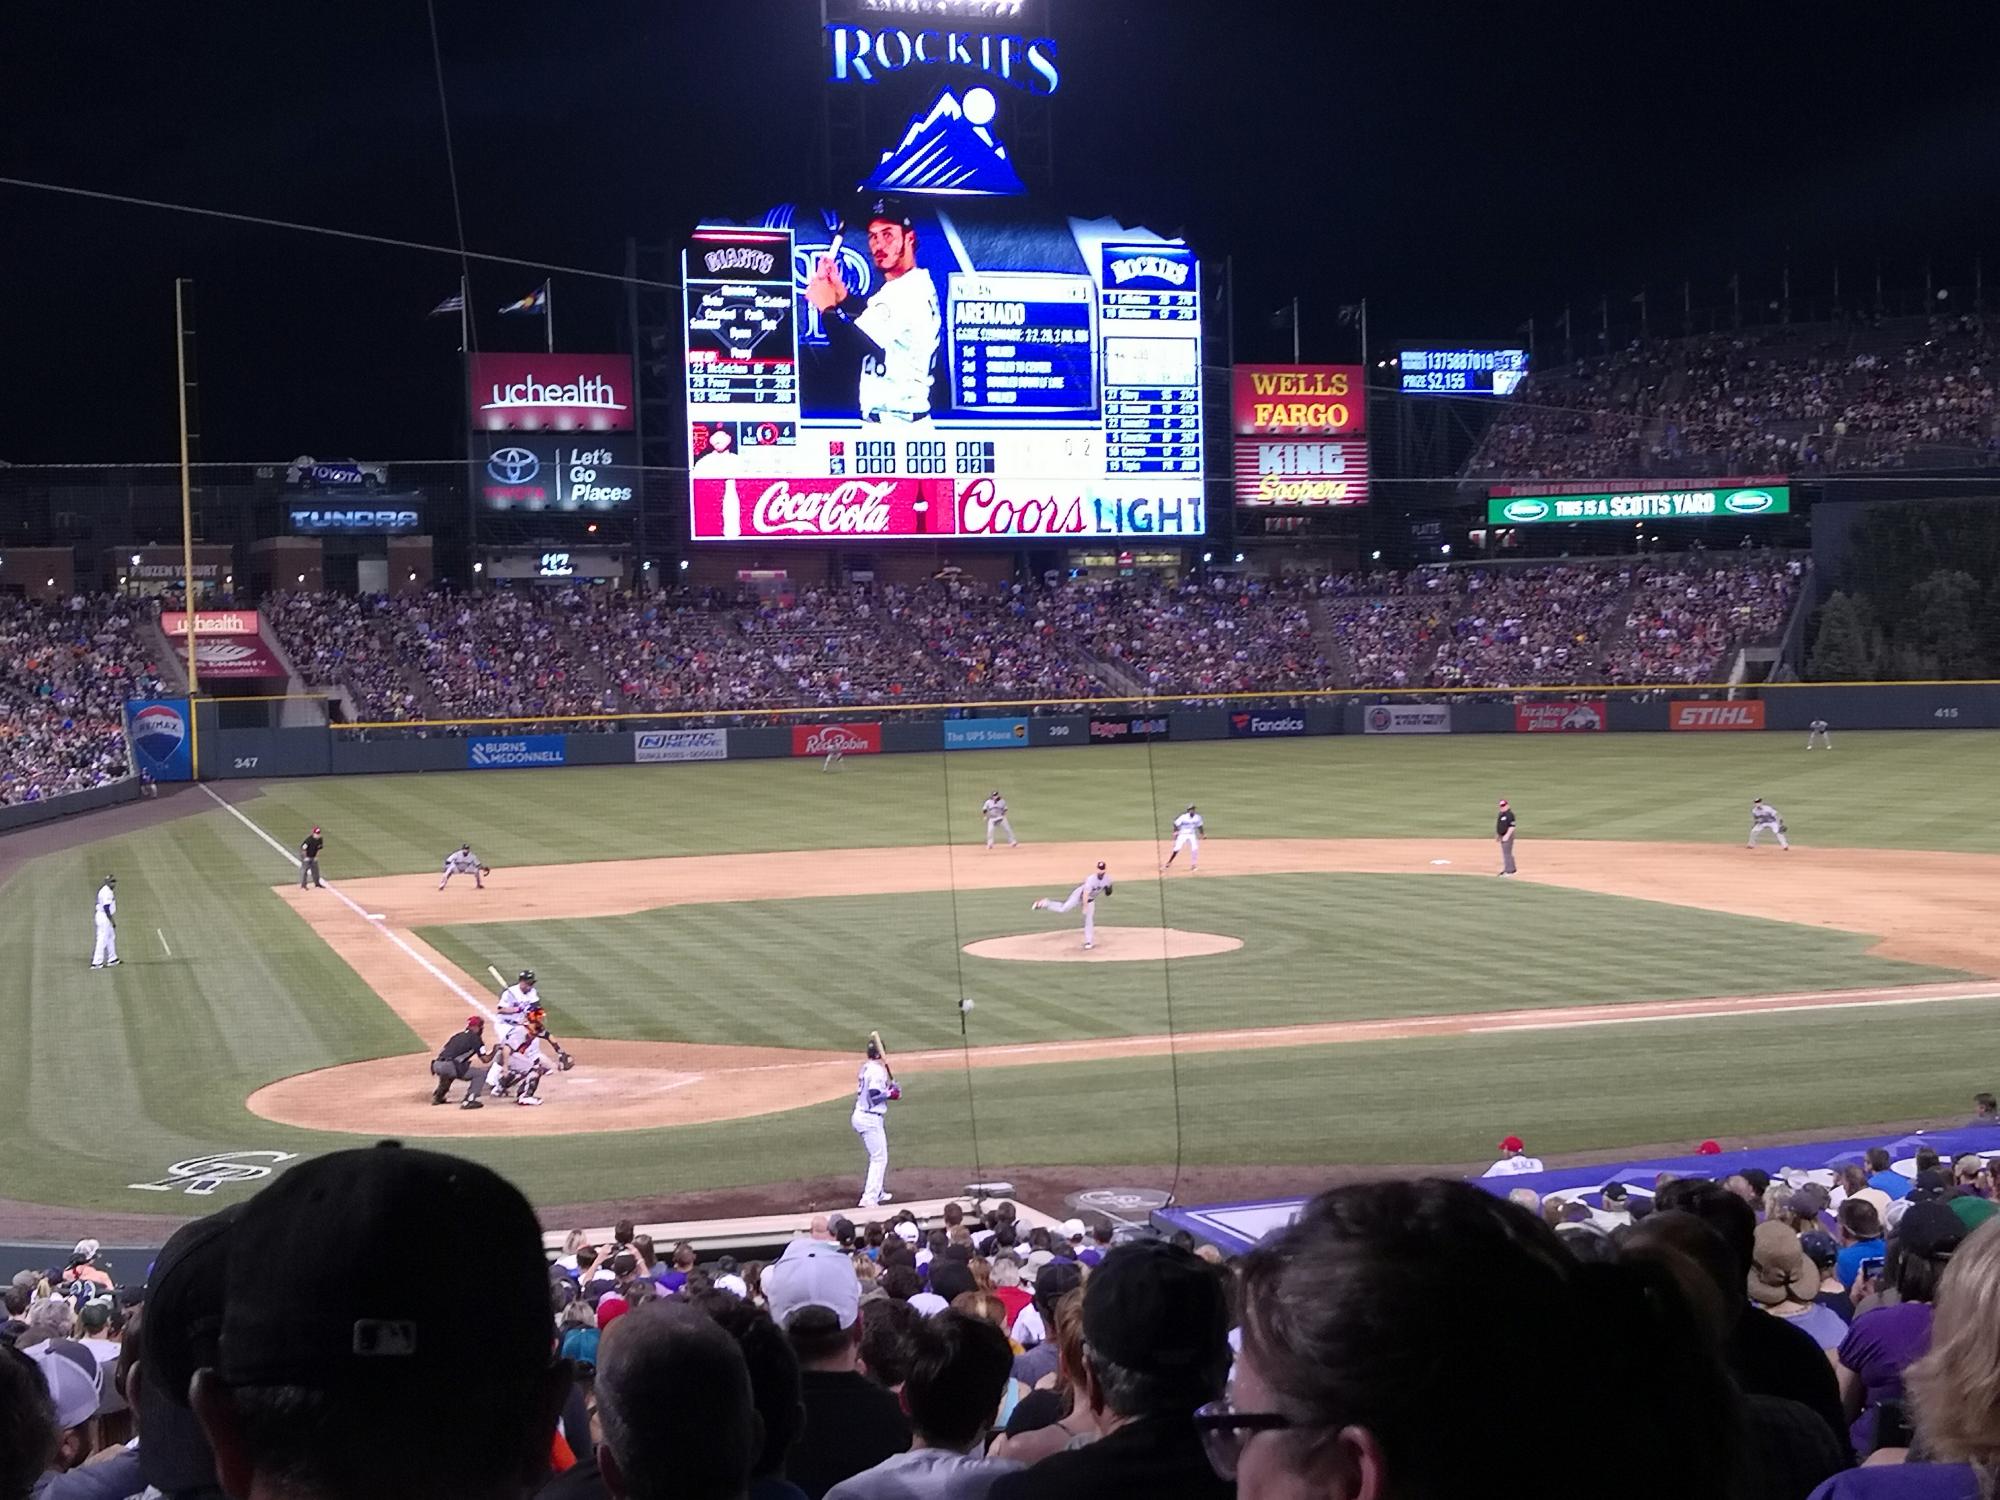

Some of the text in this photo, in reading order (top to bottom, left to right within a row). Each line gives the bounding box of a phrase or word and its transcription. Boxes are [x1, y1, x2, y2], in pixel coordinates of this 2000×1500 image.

[825, 23, 1060, 95] ROCKIES
[1110, 256, 1189, 285] ROCKIES
[955, 302, 1026, 325] ARENADO
[493, 374, 614, 406] uchealth
[1251, 373, 1349, 396] WELLS
[1427, 372, 1465, 390] $2,155
[1254, 403, 1349, 427] FARGO
[570, 449, 613, 465] Let's
[1259, 445, 1345, 475] KING
[312, 465, 362, 483] TOYOTA
[570, 467, 596, 482] Go
[571, 484, 632, 501] Places
[1257, 473, 1347, 501] Soopers
[753, 480, 898, 533] Coca-Cola
[958, 478, 1200, 534] Coors LIGHT
[1555, 501, 1583, 516] THIS
[1584, 500, 1596, 515] IS
[1597, 500, 1608, 515] A
[1610, 494, 1671, 517] SCOTTS
[1672, 493, 1715, 514] YARD
[290, 511, 418, 527] TUNDRA
[177, 614, 244, 631] uhealth
[1520, 704, 1568, 717] brakes
[1678, 706, 1754, 726] STIHL
[1934, 707, 1959, 719] 415
[1049, 725, 1069, 736] 390
[1251, 716, 1304, 732] Fanatics
[1528, 717, 1557, 730] plus
[947, 730, 1011, 743] The UPS Store
[485, 742, 527, 753] BURNS
[234, 758, 258, 768] 347
